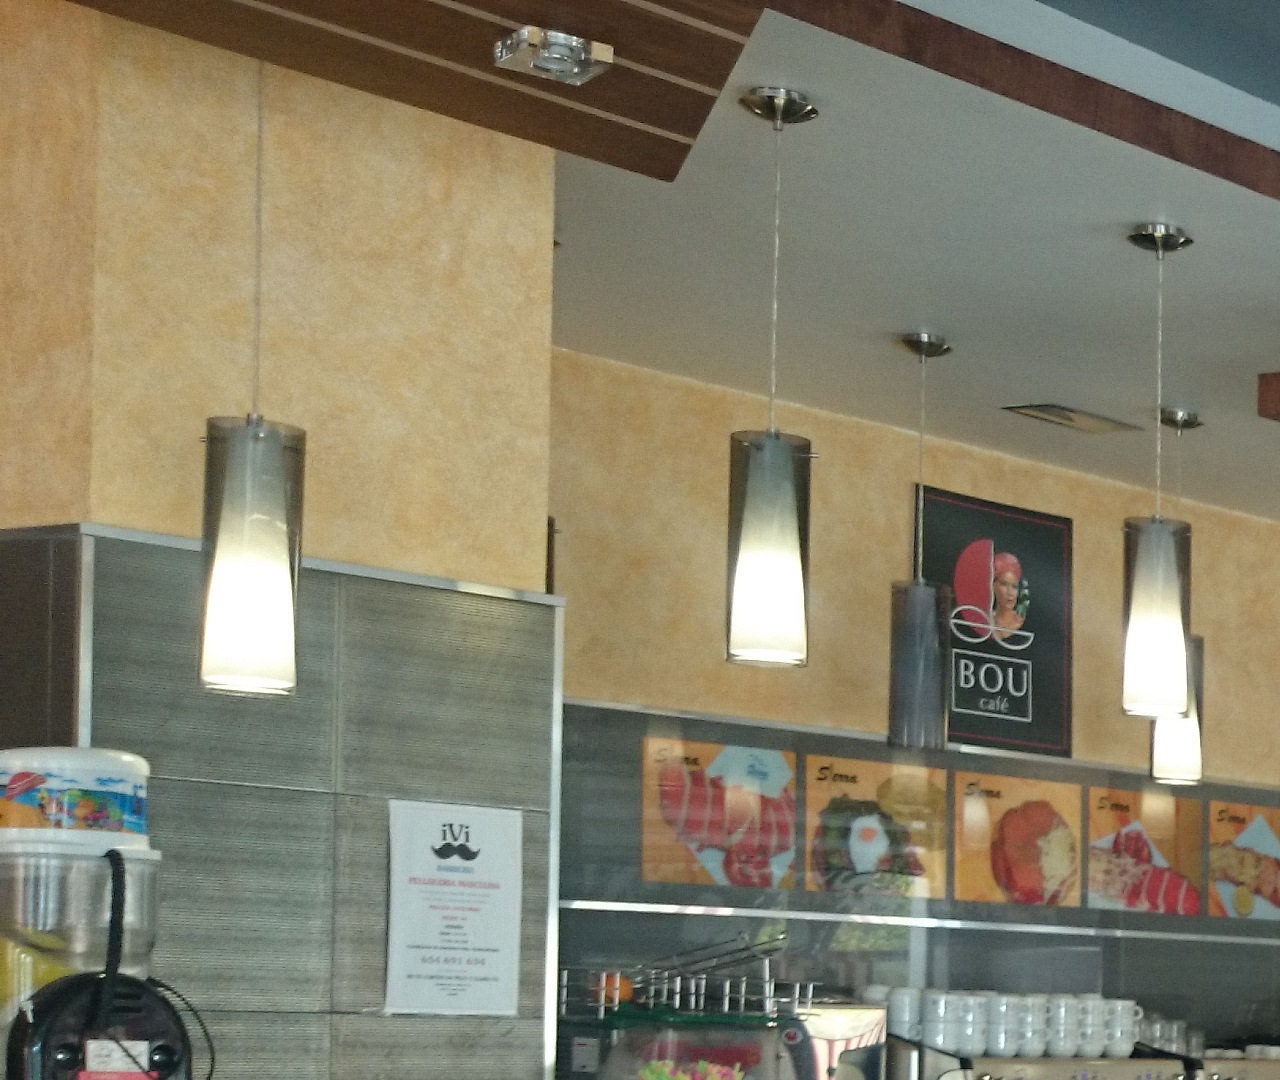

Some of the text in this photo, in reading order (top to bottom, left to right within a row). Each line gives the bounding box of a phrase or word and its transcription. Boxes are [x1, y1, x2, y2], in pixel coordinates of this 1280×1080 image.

[959, 659, 1028, 697] BOU
[979, 695, 1009, 712] café
[441, 823, 470, 843] iVi
